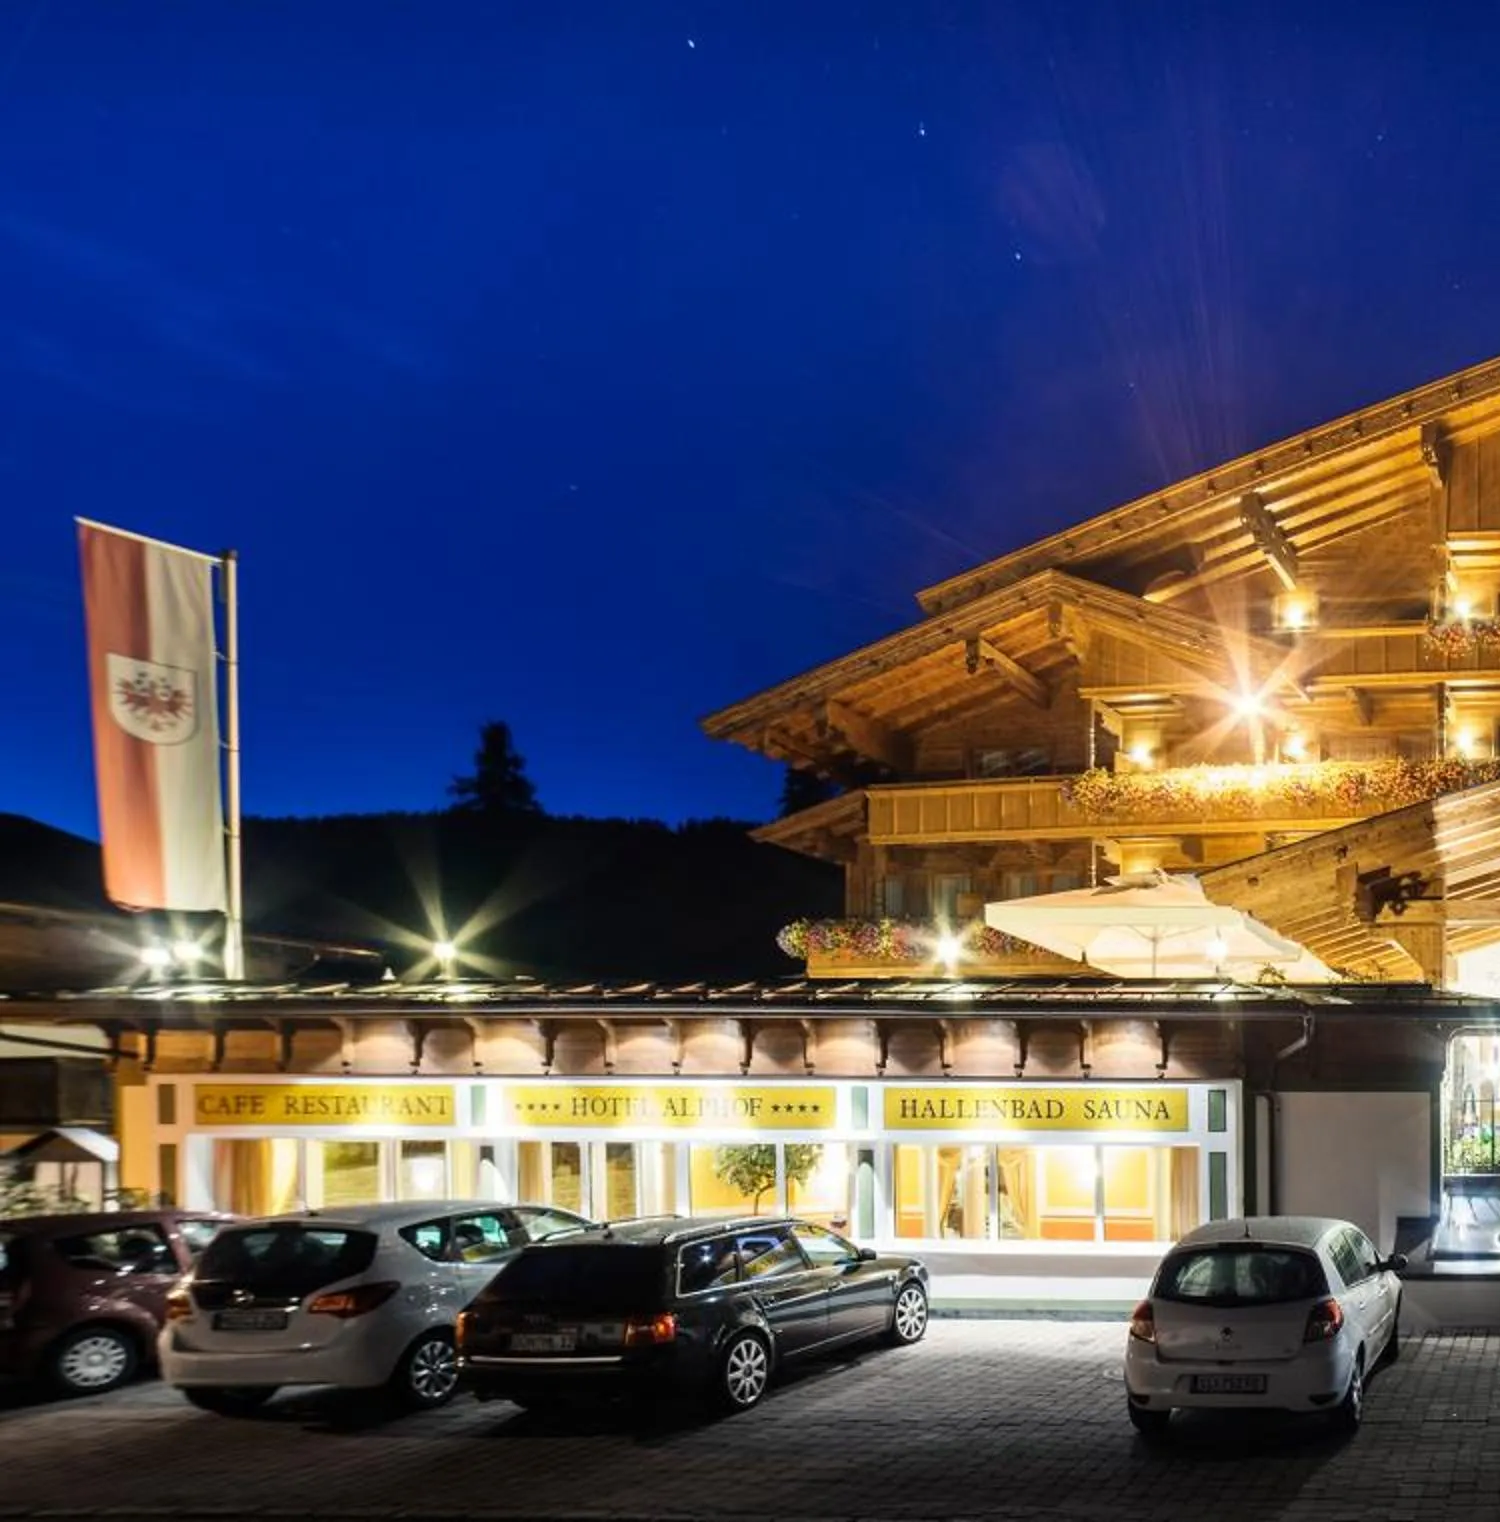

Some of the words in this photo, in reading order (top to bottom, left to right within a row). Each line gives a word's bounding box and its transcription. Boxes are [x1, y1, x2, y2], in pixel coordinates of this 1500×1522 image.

[283, 1094, 450, 1116] RESTAURANT
[571, 1096, 650, 1117] HOTEL
[662, 1096, 764, 1117] ALPHOF
[900, 1098, 1065, 1120] HALLENBAD
[1083, 1098, 1171, 1120] SAUNA
